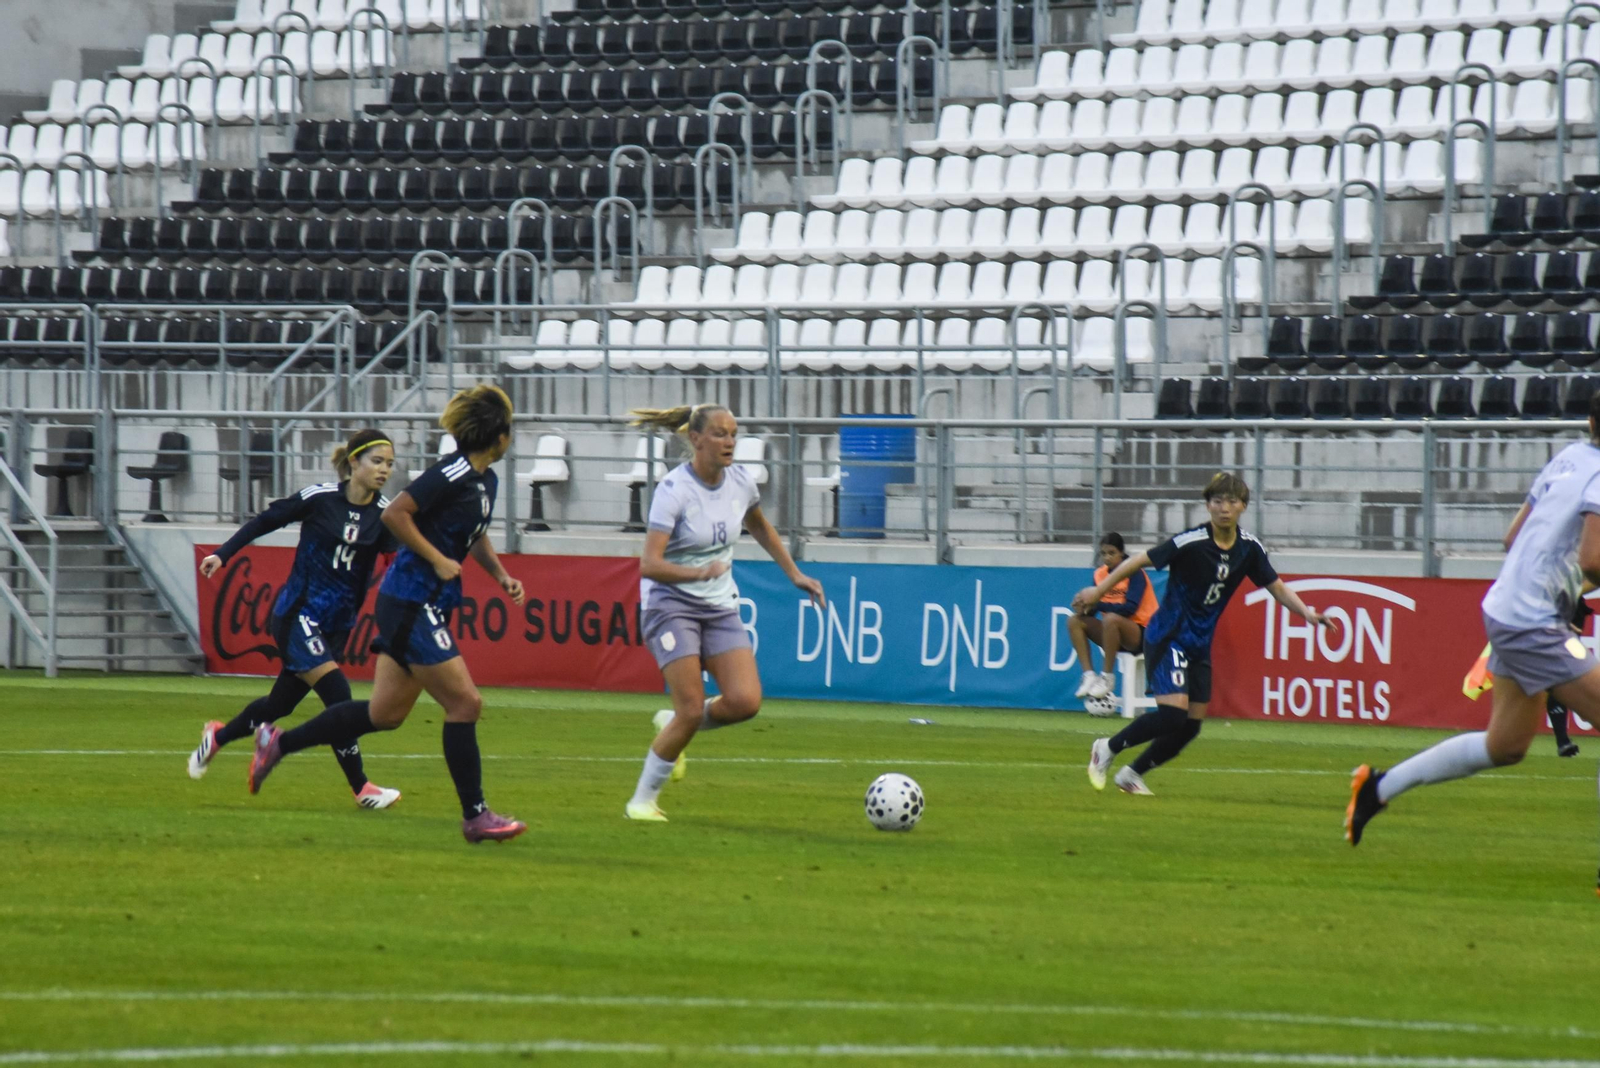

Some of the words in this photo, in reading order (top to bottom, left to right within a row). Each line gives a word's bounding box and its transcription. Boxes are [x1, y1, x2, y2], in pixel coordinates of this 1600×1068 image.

[711, 521, 727, 546] 18
[333, 544, 356, 571] 14
[1203, 583, 1226, 604] 15
[797, 576, 884, 687] DNB
[921, 579, 1010, 692] DNB
[1244, 578, 1416, 665] THON
[1263, 676, 1391, 721] HOTELS
